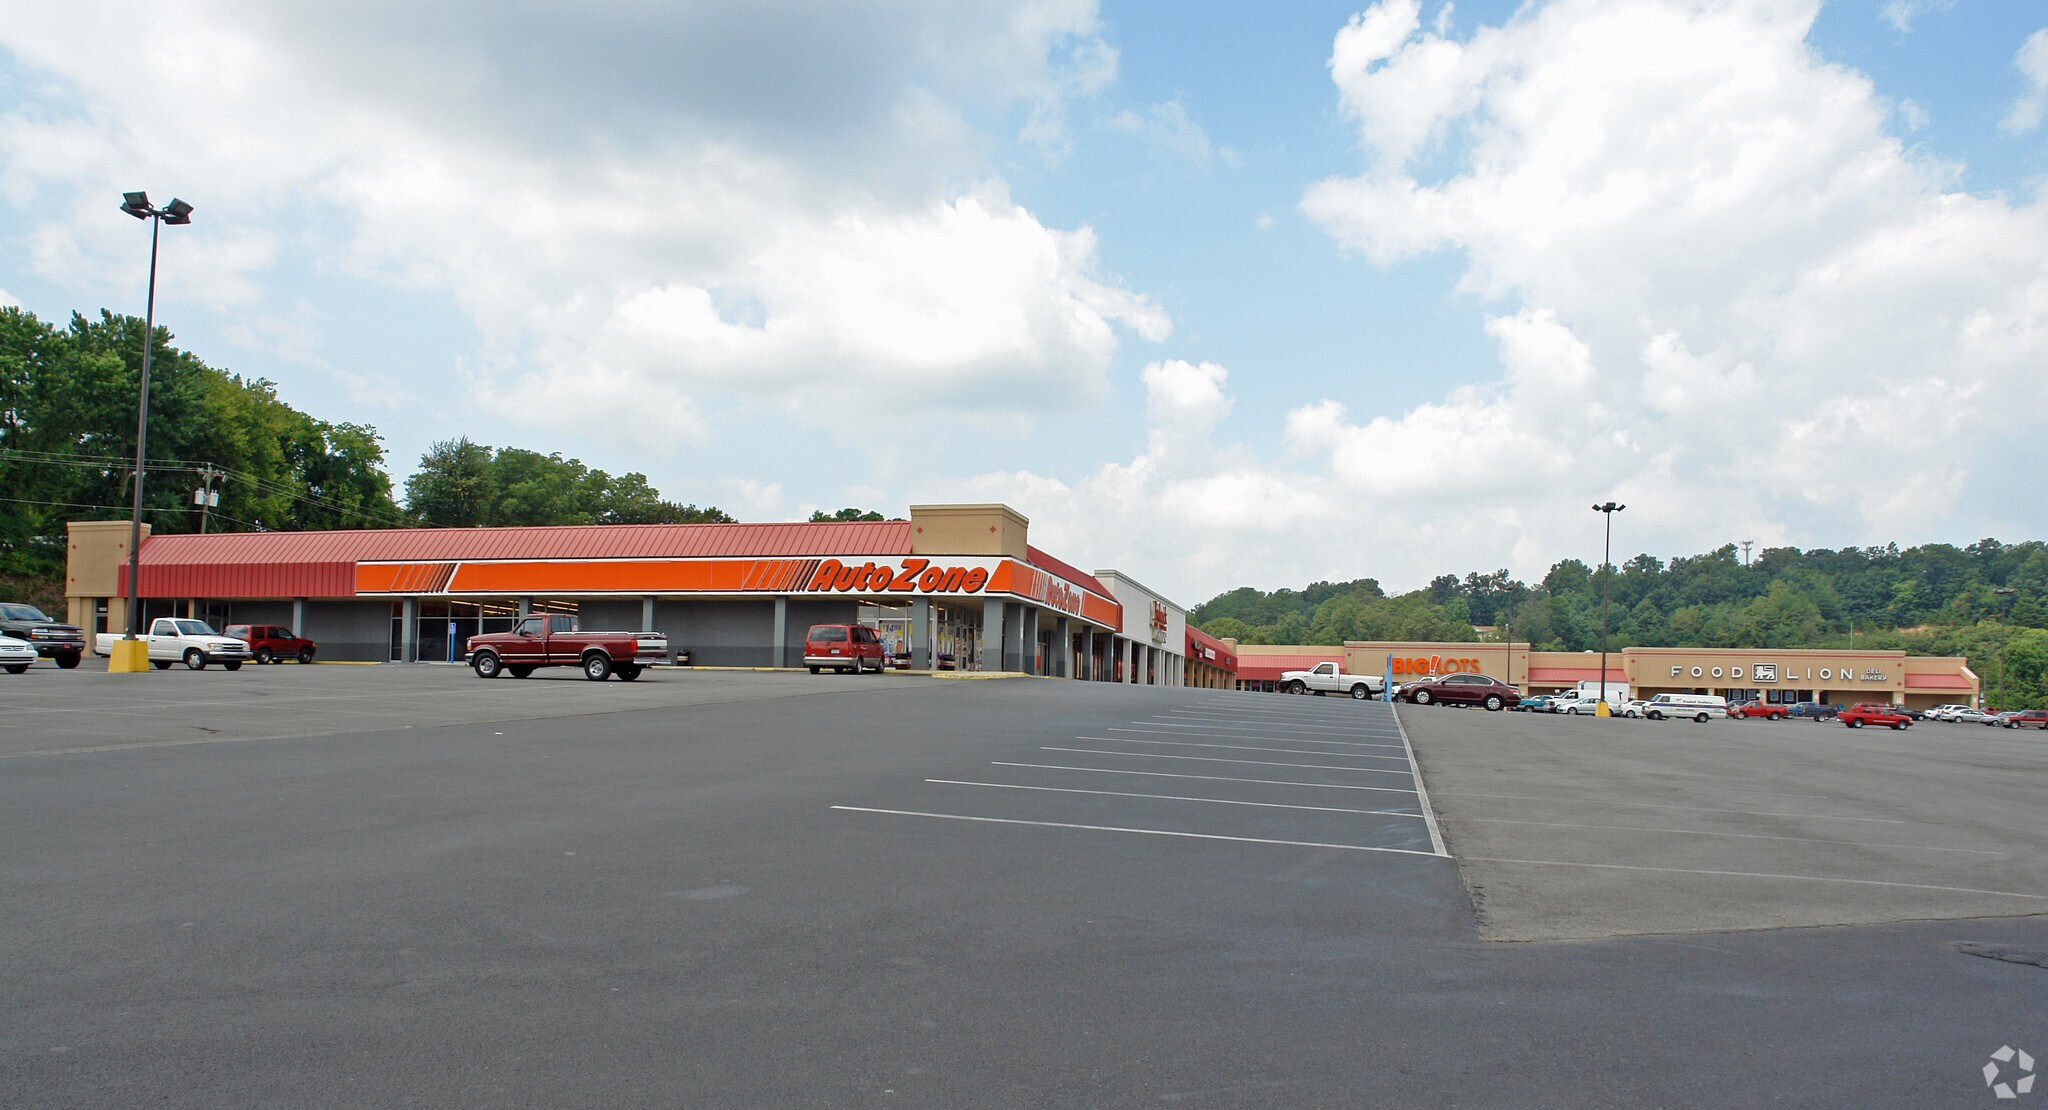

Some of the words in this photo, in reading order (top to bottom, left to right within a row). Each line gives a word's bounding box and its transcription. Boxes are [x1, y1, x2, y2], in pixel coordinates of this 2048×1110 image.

[807, 558, 989, 593] AutoZone
[1670, 665, 1744, 678] FOOD
[1786, 667, 1853, 680] LION
